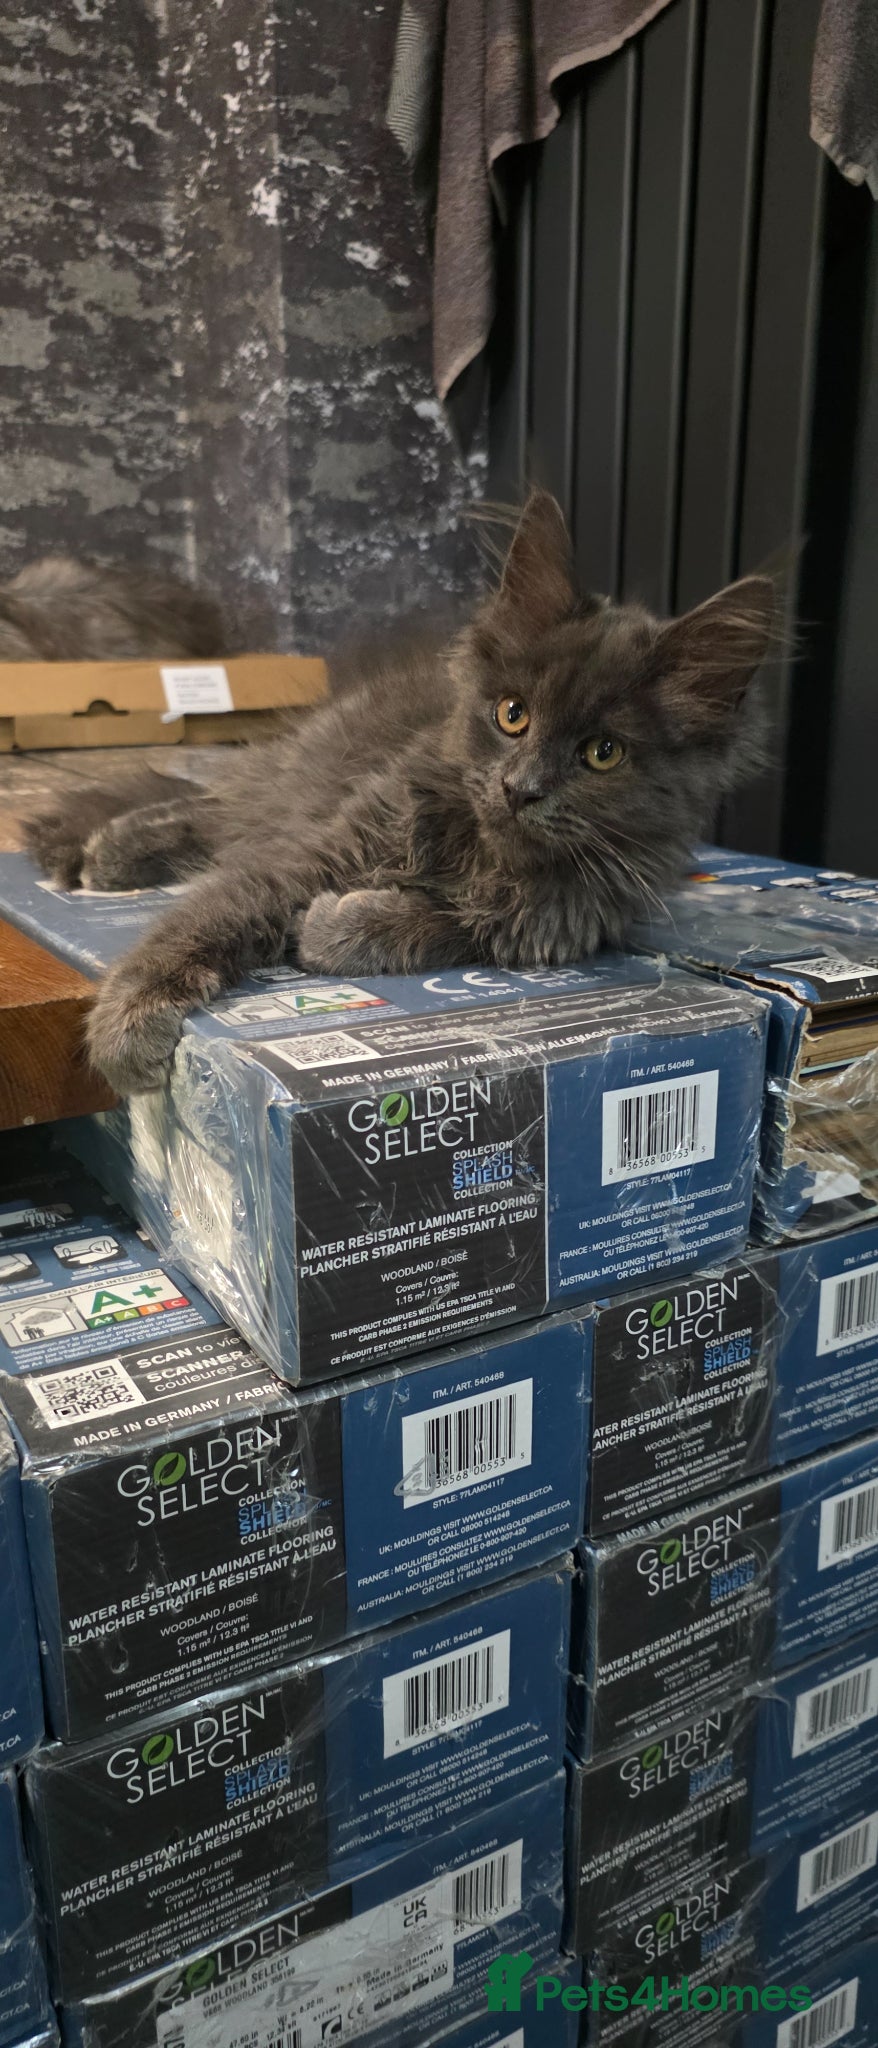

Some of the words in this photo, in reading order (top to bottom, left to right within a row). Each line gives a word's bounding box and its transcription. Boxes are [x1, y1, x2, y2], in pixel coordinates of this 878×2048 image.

[322, 1073, 364, 1088] MADE
[368, 1071, 380, 1081] IN
[384, 1060, 448, 1078] GERMANY
[548, 1027, 617, 1049] ALLEMAGNE
[630, 1068, 645, 1079] ITM.
[651, 1063, 666, 1074] ART.
[348, 1077, 491, 1133] GOLDEN
[365, 1112, 479, 1165] SELECT
[453, 1140, 513, 1161] COLLECTION
[453, 1151, 513, 1176] SPLASH
[608, 1167, 613, 1175] 8
[626, 1156, 656, 1171] 36568
[701, 1145, 706, 1153] 5
[453, 1164, 513, 1191] SHIELD
[454, 1179, 513, 1200] COLLECTION
[626, 1178, 649, 1191] STYLE:
[302, 1240, 344, 1260] WATER
[349, 1222, 416, 1249] RESISTANT
[420, 1208, 476, 1232] LAMINATE
[480, 1192, 537, 1216] FLOORING
[300, 1251, 368, 1279] PLANCHER
[371, 1231, 431, 1260] STRATIFIÉ
[434, 1217, 496, 1244] RÉSISTANT
[499, 1212, 506, 1226] À
[508, 1207, 538, 1224] L'EAU
[381, 1261, 434, 1283] WOODLAND
[440, 1250, 468, 1268] BOISÉ
[395, 1280, 422, 1294] Covers
[430, 1270, 458, 1285] Couvre:
[90, 1284, 163, 1315] A+
[330, 1329, 347, 1341] THIS
[349, 1320, 380, 1335] PRODUCT
[382, 1310, 417, 1326] COMPLIES
[418, 1305, 434, 1316] WITH
[436, 1302, 445, 1311] US
[446, 1298, 459, 1308] EPA
[460, 1293, 477, 1305] TSCA
[478, 1288, 494, 1300] TITLE
[502, 1282, 515, 1293] AND
[396, 1294, 412, 1306] 1.15
[626, 1277, 738, 1335] GOLDEN
[637, 1308, 727, 1360] SELECT
[704, 1327, 752, 1349] COLLECTION
[704, 1337, 751, 1360] SPLASH
[136, 1346, 192, 1370] SCAN
[196, 1337, 213, 1354] to
[704, 1347, 751, 1373] SHIELD
[704, 1358, 751, 1380] COLLECTION
[154, 1365, 236, 1392] couleures
[433, 1388, 448, 1400] ITM.
[455, 1380, 472, 1393] ART.
[475, 1371, 504, 1387] 540468
[620, 1400, 674, 1429] RESISTANT
[676, 1383, 720, 1409] LAMINATE
[687, 1391, 734, 1418] RÉSISTANT
[74, 1425, 121, 1448] MADE
[124, 1420, 141, 1435] IN
[144, 1399, 220, 1429] GERMANY
[117, 1419, 281, 1498] GOLDEN
[137, 1456, 266, 1527] SELECT
[238, 1479, 306, 1507] COLLECTION
[433, 1493, 458, 1509] STYLE:
[240, 1517, 308, 1546] COLLECTION
[379, 1543, 392, 1556] UK:
[394, 1526, 441, 1550] MOULDINGS
[443, 1519, 460, 1533] VISIT
[462, 1484, 552, 1525] WWW.GOLDENSELECT.CA
[617, 1525, 648, 1542] MADE
[428, 1535, 440, 1546] OR
[441, 1528, 459, 1542] CALL
[637, 1508, 742, 1575] GOLDEN
[70, 1604, 117, 1631] WATER
[122, 1575, 198, 1612] RESISTANT
[202, 1550, 266, 1583] LAMINATE
[269, 1525, 334, 1559] FLOORING
[648, 1538, 732, 1596] SELECT
[711, 1553, 756, 1578] COLLECTION
[70, 1609, 144, 1646] PLANCHER
[150, 1580, 216, 1617] STRATIFIÉ
[220, 1556, 289, 1591] RÉSISTANT
[710, 1570, 754, 1600] SHIELD
[160, 1608, 220, 1638] WOODLAND
[229, 1591, 258, 1613] BOISÉ
[599, 1652, 630, 1676] WATER
[632, 1628, 680, 1660] RESISTANT
[683, 1607, 725, 1636] LAMINATE
[597, 1656, 647, 1689] PLANCHER
[106, 1694, 265, 1778] GOLDEN
[620, 1712, 722, 1780] GOLDEN
[126, 1730, 252, 1804] SELECT
[224, 1756, 290, 1789] SPLASH
[225, 1764, 290, 1802] SHIELD
[629, 1738, 712, 1799] SELECT
[226, 1776, 290, 1810] COLLECTION
[61, 1874, 134, 1917] PLANCHER
[138, 1841, 202, 1883] STRATIFIÉ
[206, 1813, 273, 1852] RÉSISTANT
[276, 1805, 285, 1821] À
[288, 1792, 318, 1815] L'EAU
[62, 1873, 108, 1903] WATER
[112, 1839, 184, 1881] RESISTANT
[189, 1810, 250, 1847] LAMINATE
[254, 1781, 315, 1818] FLOORING
[404, 1896, 426, 1915] UK
[404, 1910, 428, 1928] CA
[635, 1876, 730, 1948] GOLDEN
[645, 1902, 720, 1964] SELECT
[203, 1978, 247, 2007] GOLDEN
[251, 1957, 290, 1982] SELECT
